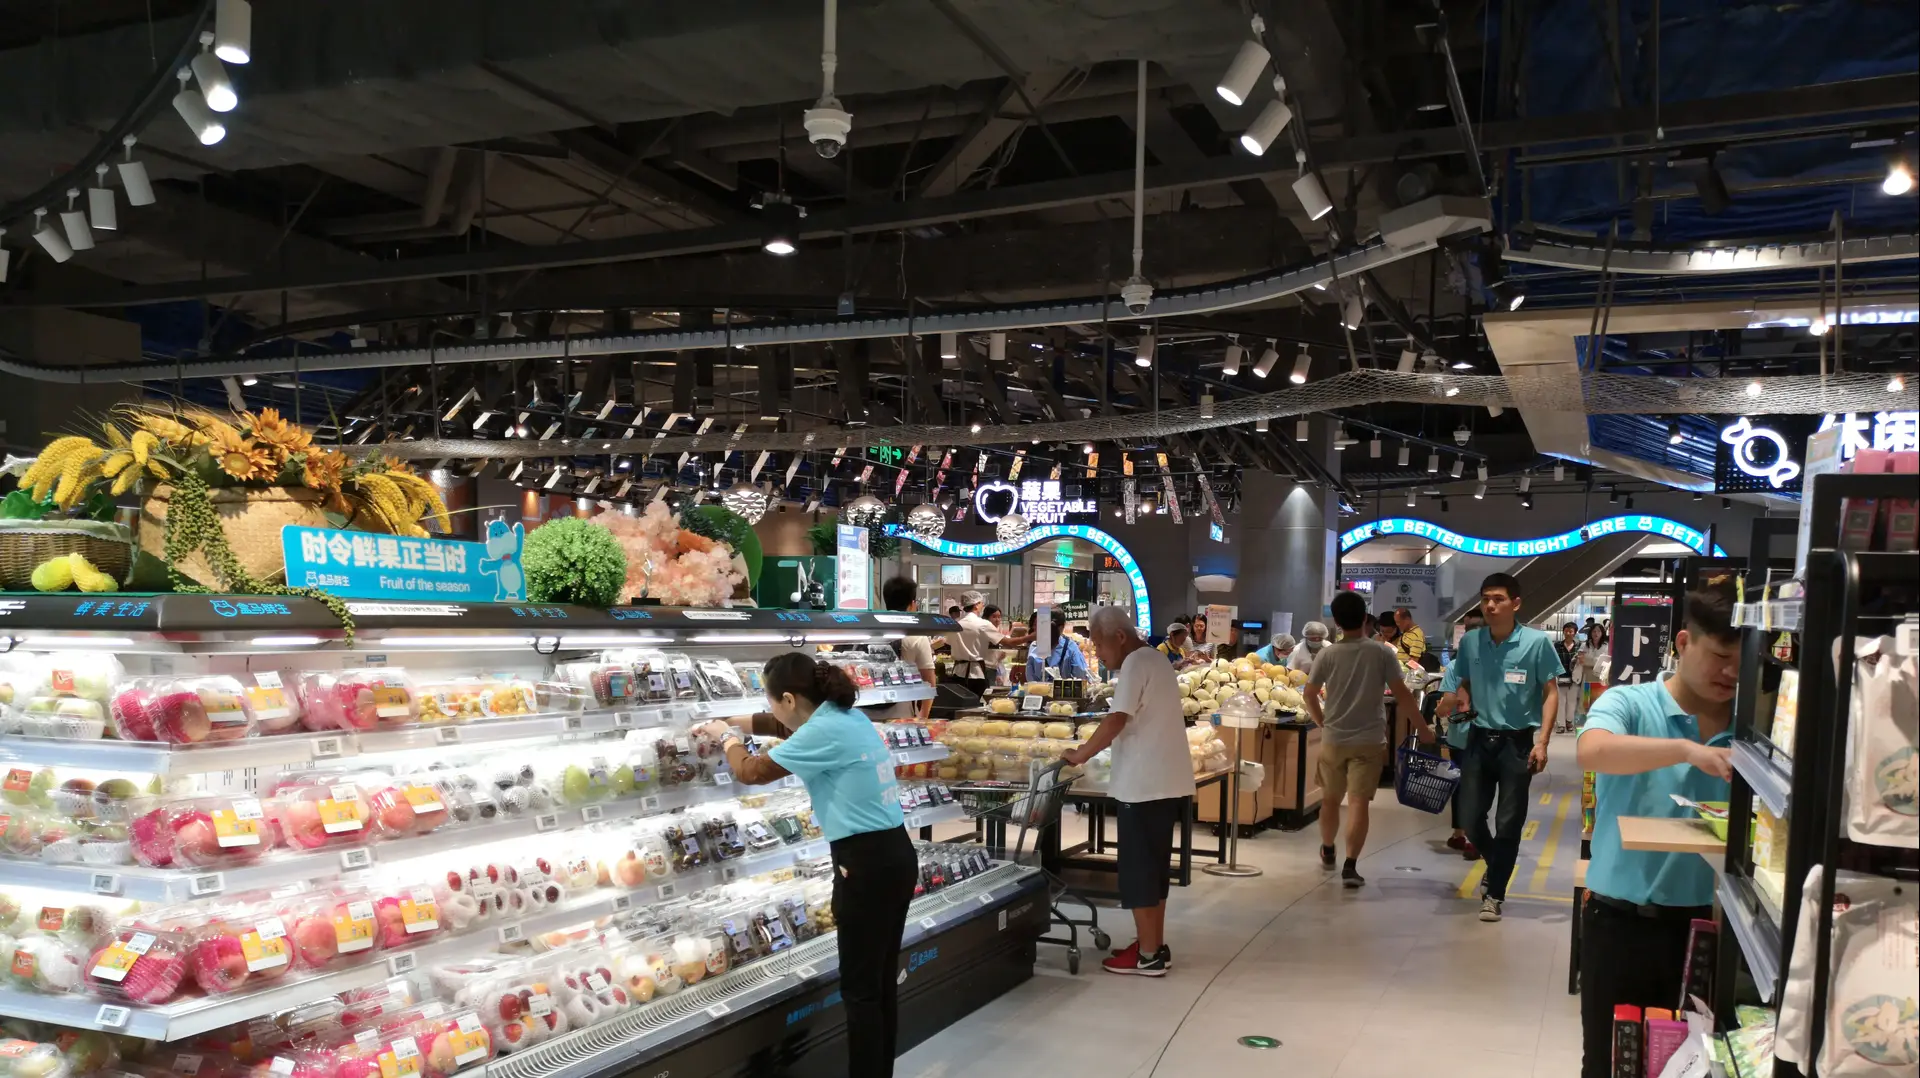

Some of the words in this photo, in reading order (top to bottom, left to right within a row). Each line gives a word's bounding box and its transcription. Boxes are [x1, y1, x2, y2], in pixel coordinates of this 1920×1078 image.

[1021, 501, 1096, 513] VEGETABLE
[301, 531, 467, 573] 时令鲜果正当时
[1404, 520, 1465, 548] BETTER
[1473, 541, 1509, 555] LIFE
[1517, 535, 1570, 555] RIGHT
[949, 544, 975, 556] LIFE
[1086, 526, 1132, 567] BETTER
[1128, 568, 1147, 599] LIFE
[380, 575, 404, 590] Fruit
[405, 577, 416, 590] of
[417, 578, 434, 591] the
[435, 581, 470, 592] season
